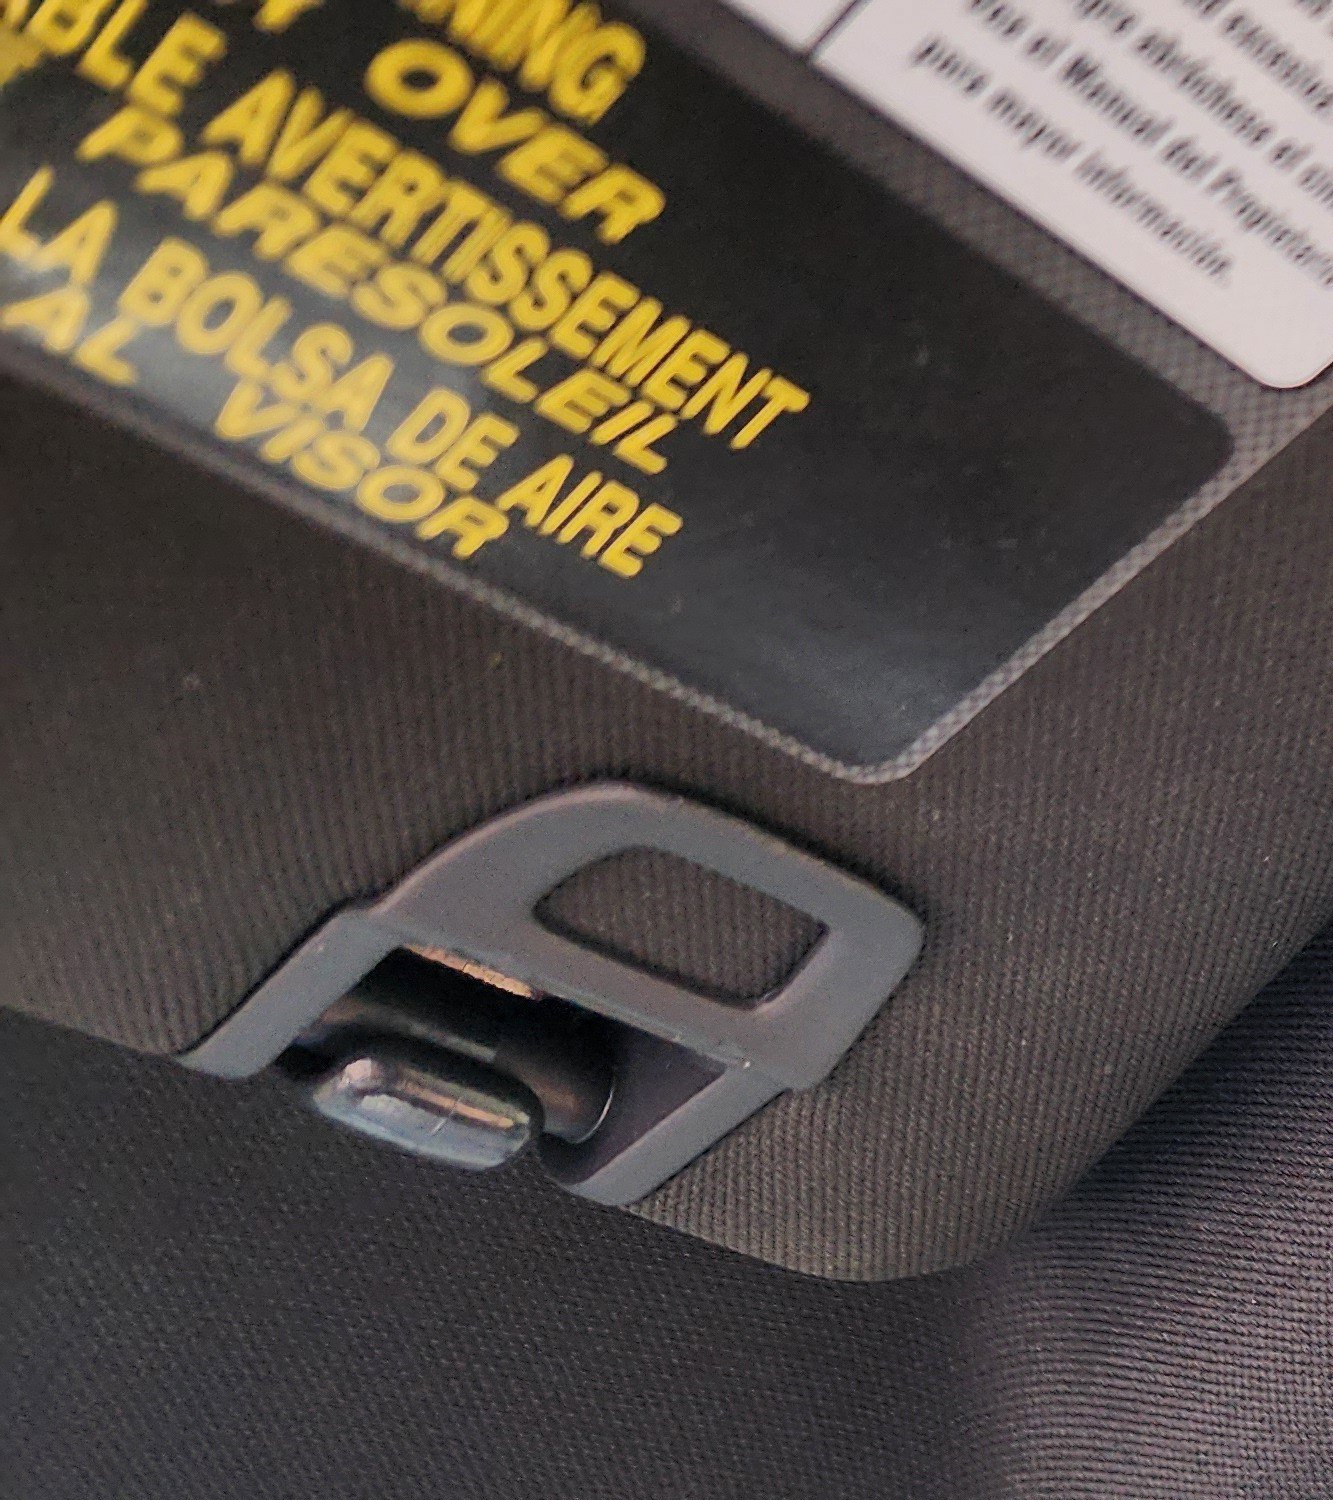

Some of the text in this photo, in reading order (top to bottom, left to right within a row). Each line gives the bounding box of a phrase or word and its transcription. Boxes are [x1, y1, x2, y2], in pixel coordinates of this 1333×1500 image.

[364, 38, 666, 243] OVER
[1057, 51, 1177, 147] Manual
[0, 165, 684, 579] LA BOLSA DE AIRE
[203, 68, 809, 449] AVERTISSEMENT
[0, 284, 510, 560] AL VISOR
